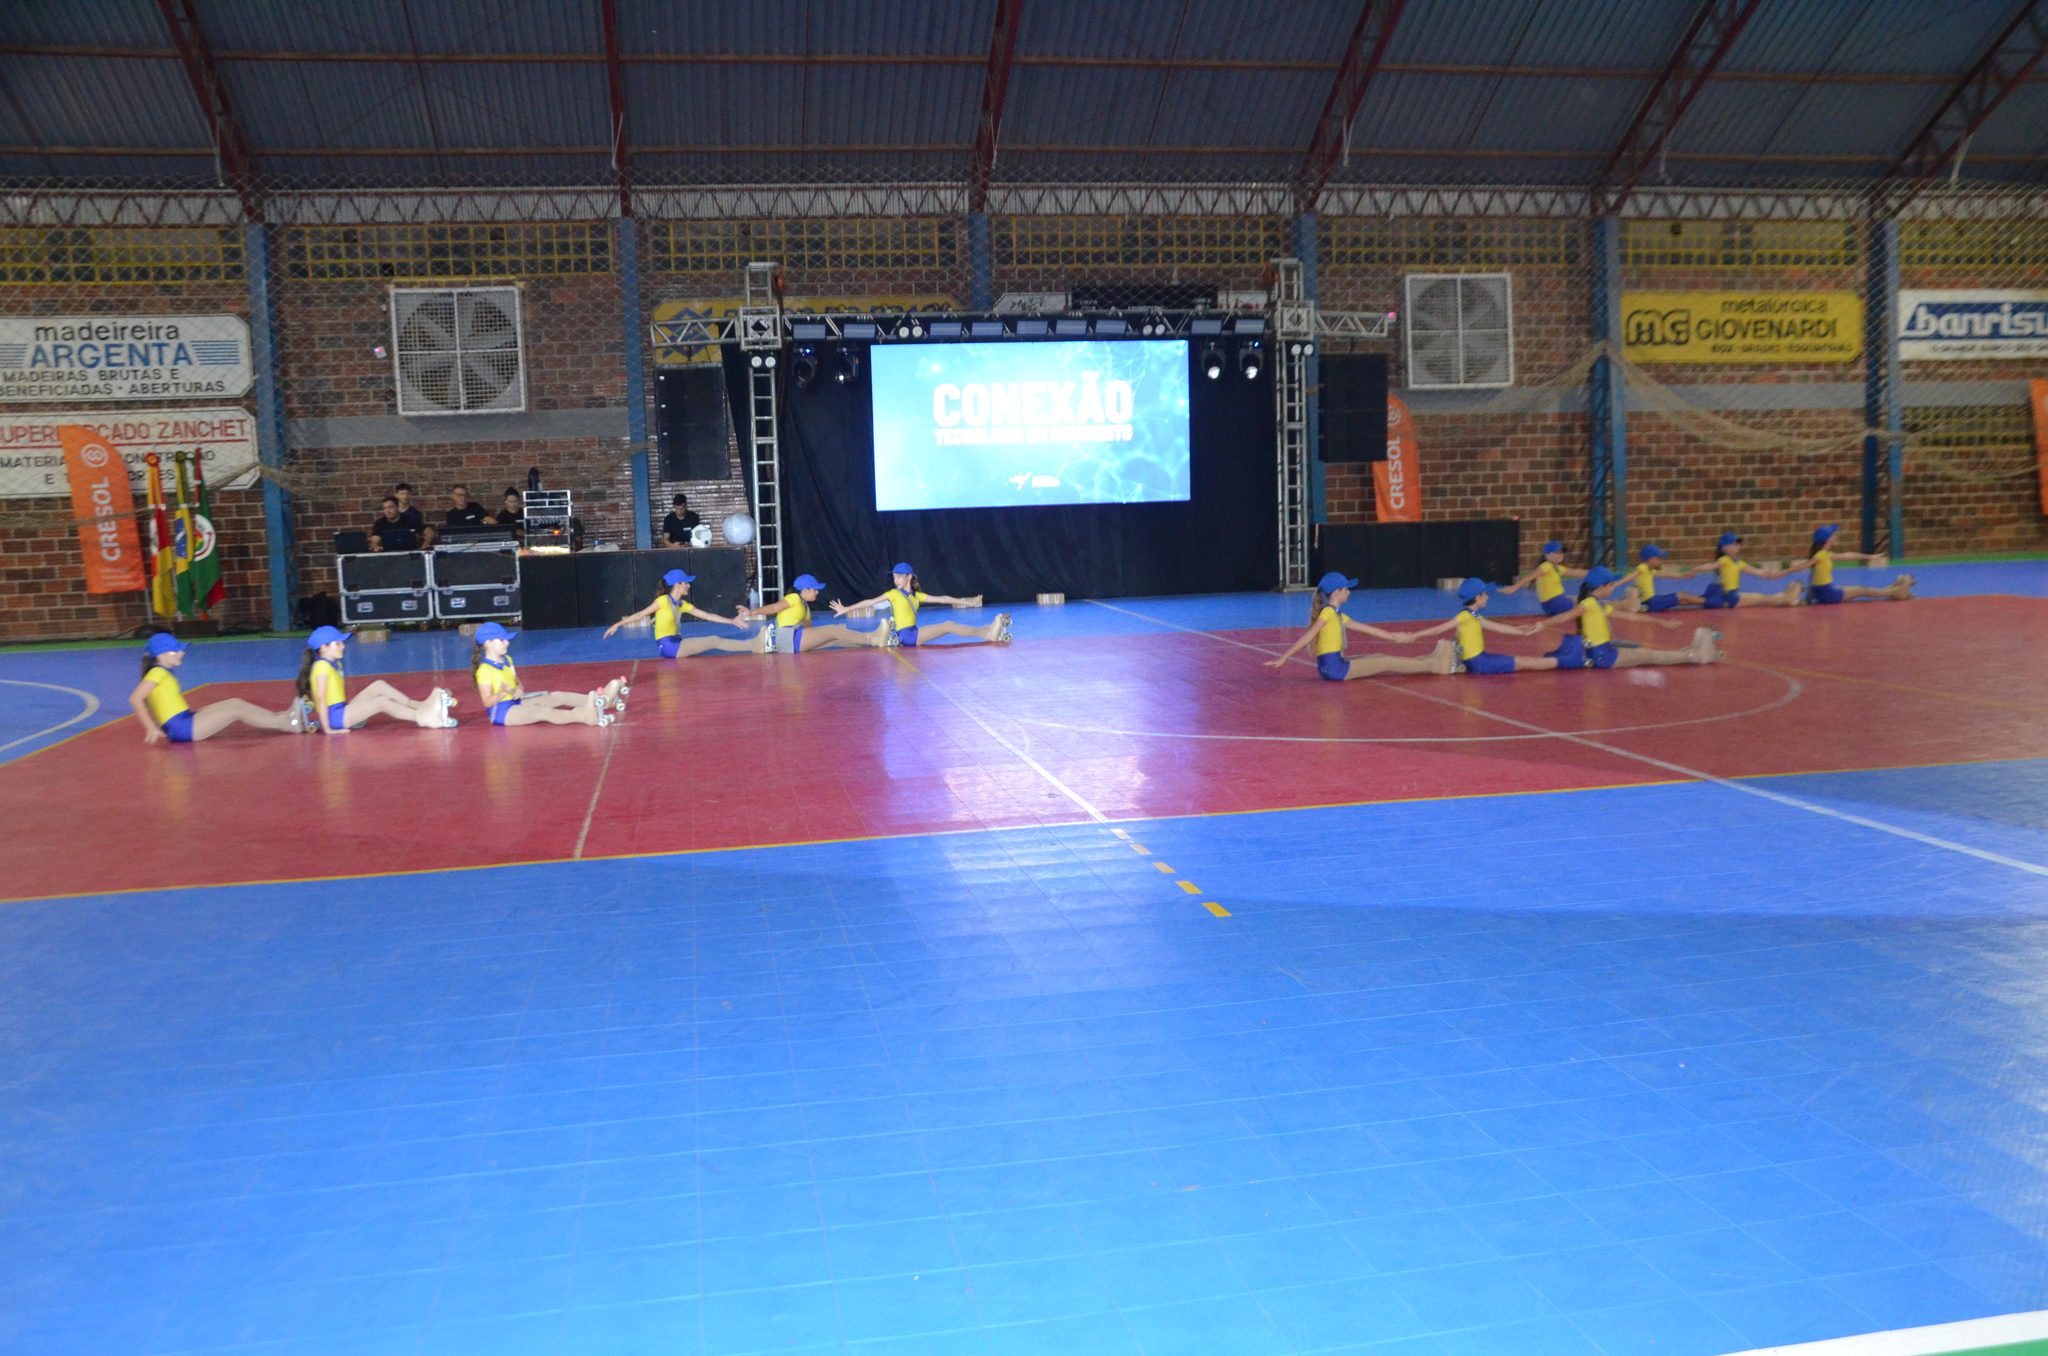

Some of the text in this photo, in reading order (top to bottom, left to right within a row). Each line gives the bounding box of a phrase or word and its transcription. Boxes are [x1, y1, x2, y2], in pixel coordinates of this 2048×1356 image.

[35, 322, 180, 341] madeireira
[1695, 318, 1838, 340] GIOVENARDI
[30, 342, 193, 368] ARGENTA
[3, 368, 180, 383] MADEIRAS BRUTAS E
[129, 380, 225, 395] ABERTURAS
[933, 370, 1134, 428] CONEXÃO
[157, 419, 247, 439] ZANCHET
[45, 473, 54, 485] E
[1387, 435, 1405, 510] CRESOL
[91, 476, 121, 561] CRESOL
